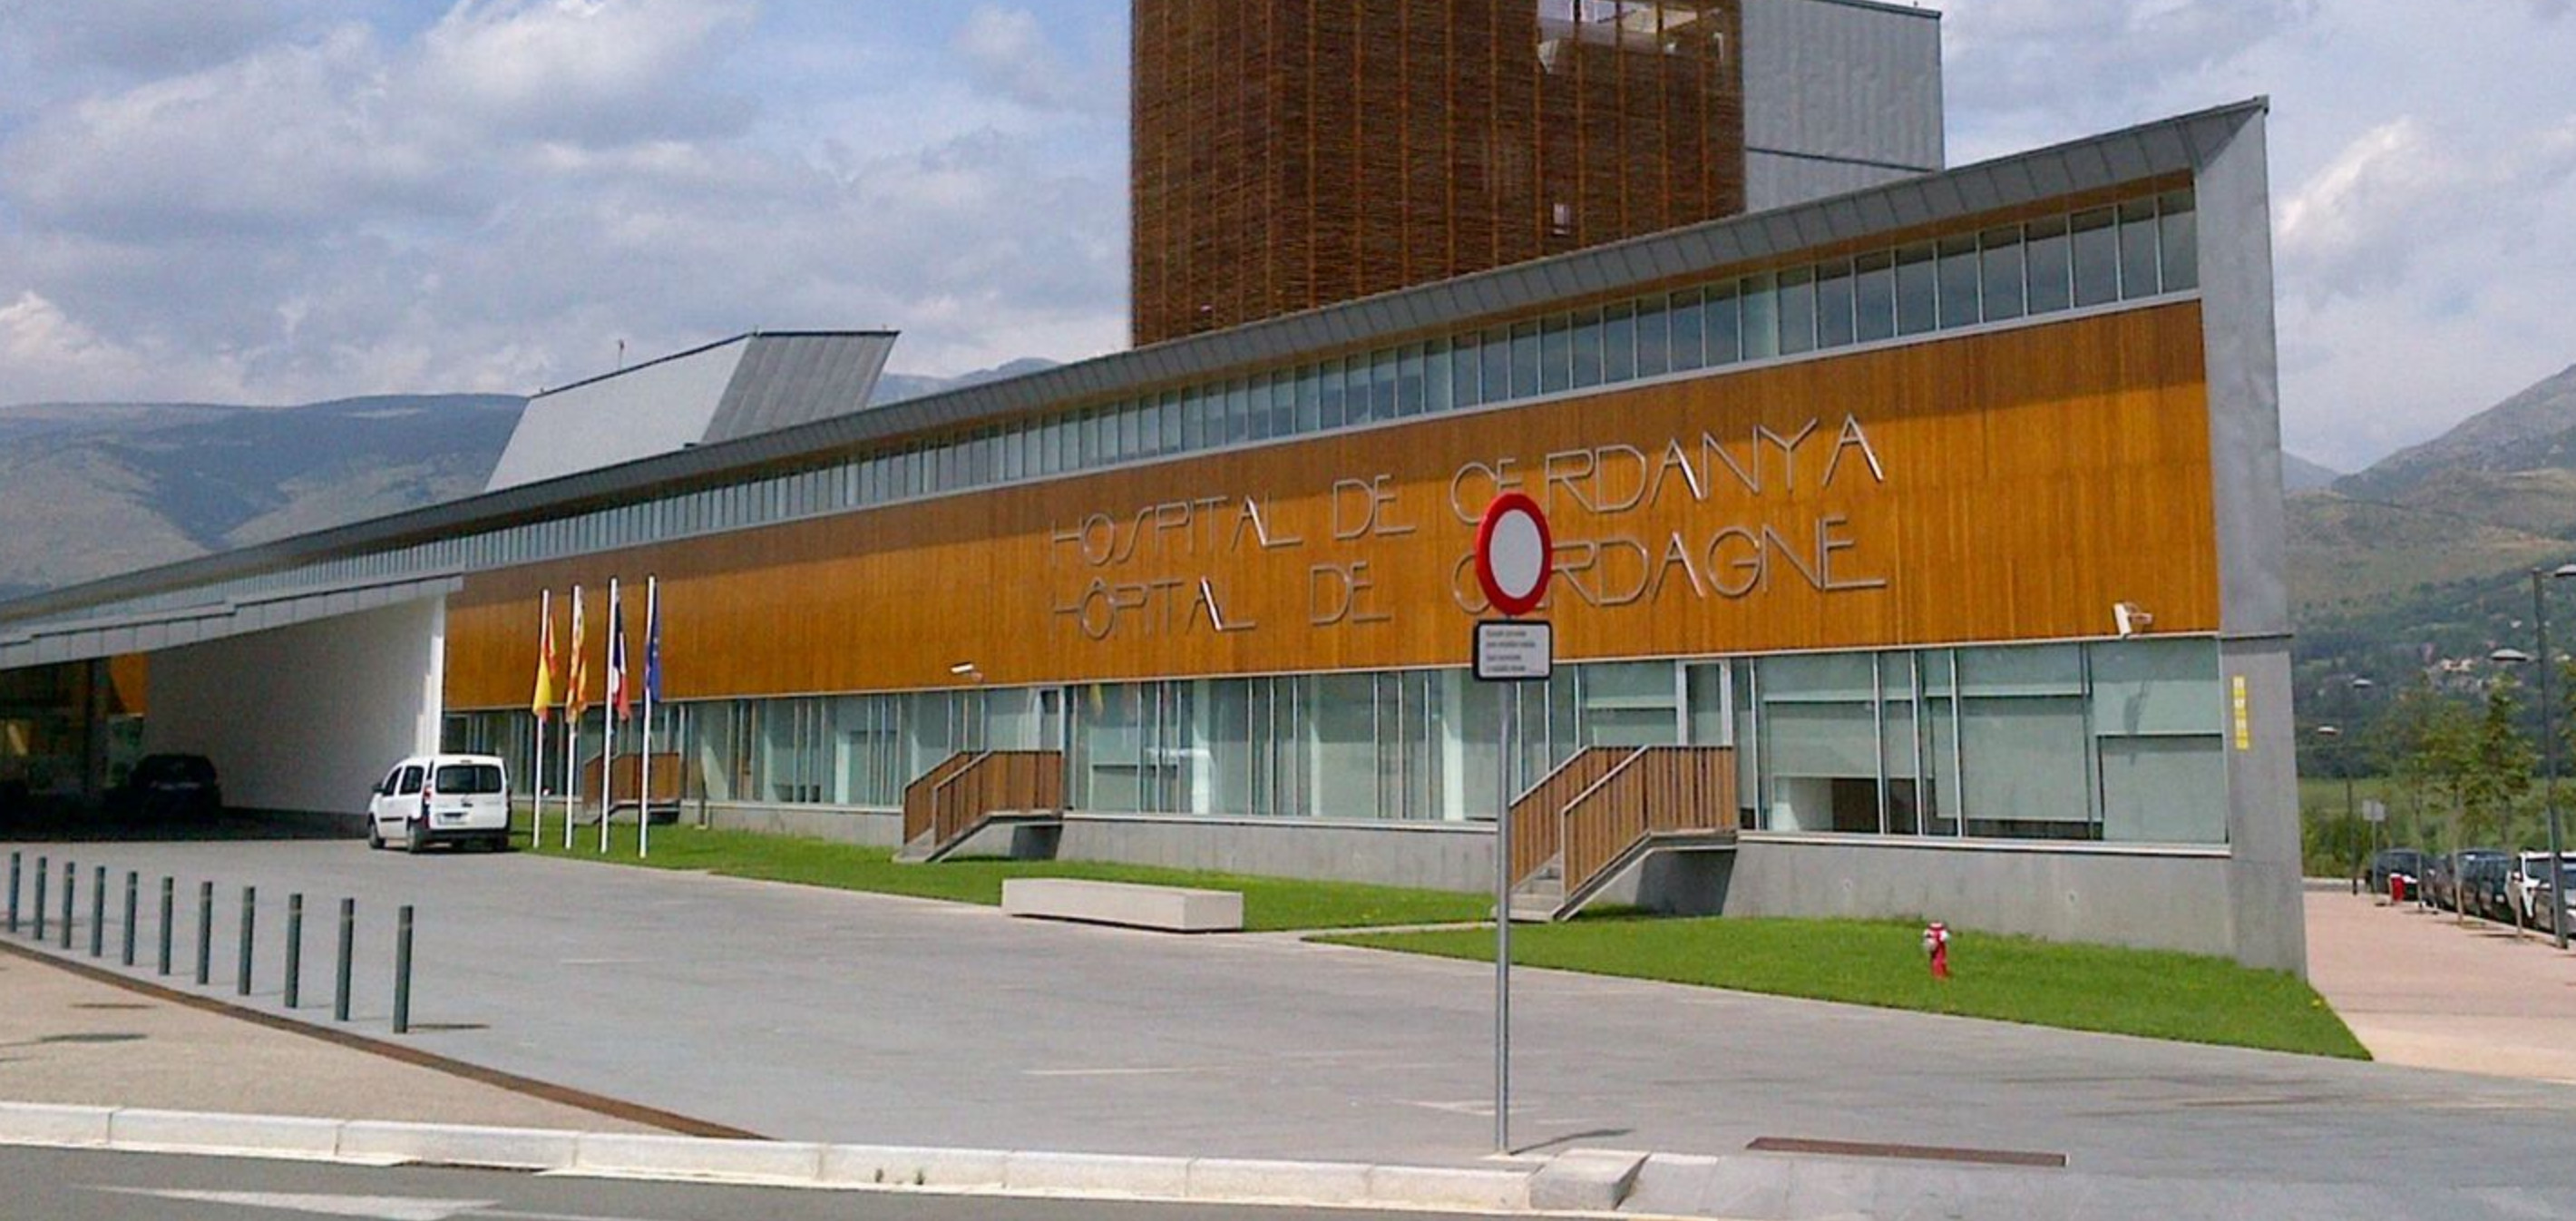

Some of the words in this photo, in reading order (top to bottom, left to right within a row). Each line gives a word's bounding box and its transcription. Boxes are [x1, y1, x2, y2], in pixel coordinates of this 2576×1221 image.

[1051, 492, 1303, 566] HOSPITAL
[1333, 474, 1416, 540] DE
[1052, 576, 1257, 640] HÔPITAL
[1311, 561, 1390, 625] DE
[1454, 515, 1888, 613] CRDAGNE
